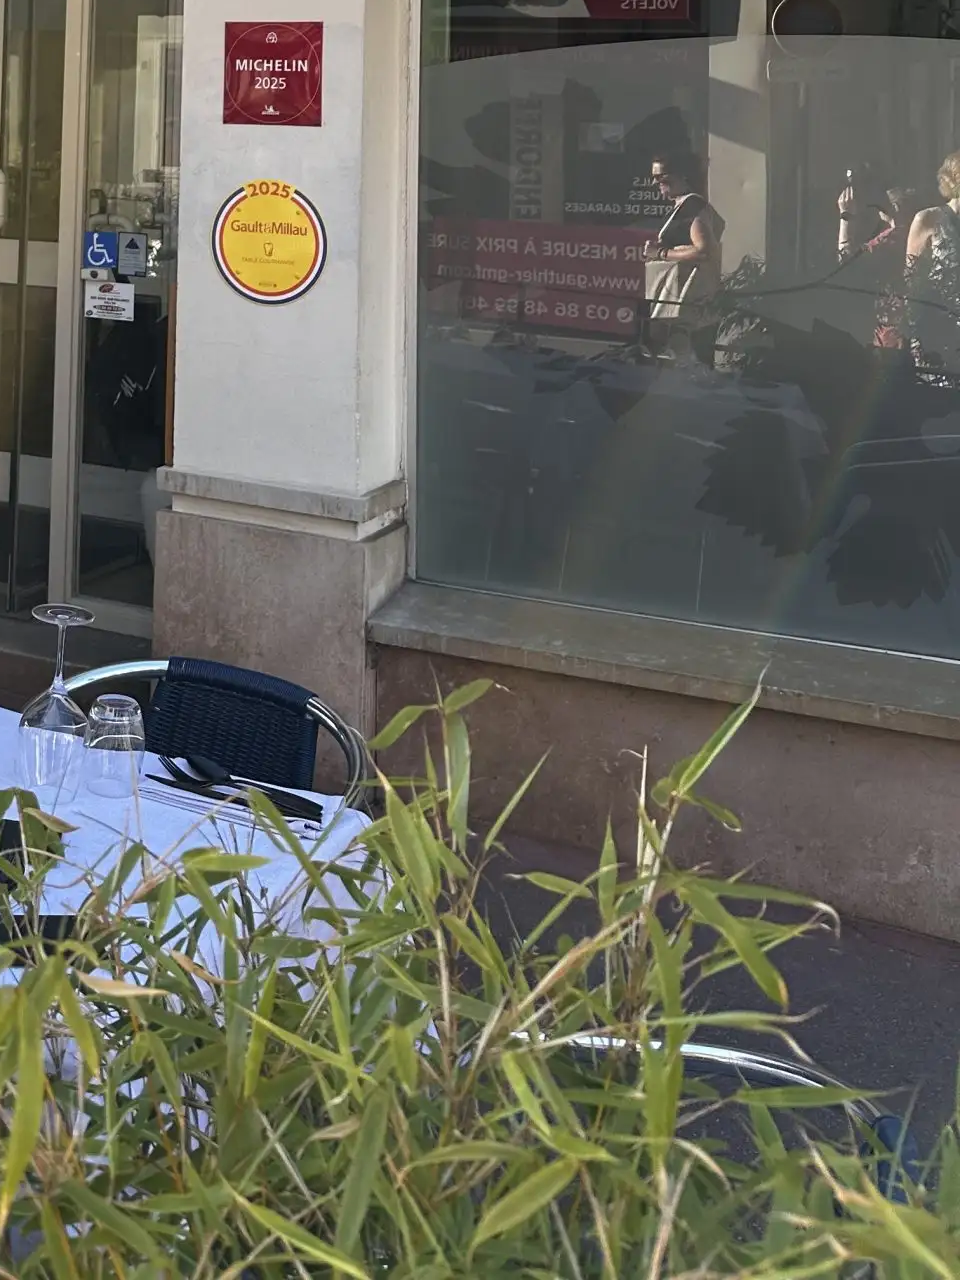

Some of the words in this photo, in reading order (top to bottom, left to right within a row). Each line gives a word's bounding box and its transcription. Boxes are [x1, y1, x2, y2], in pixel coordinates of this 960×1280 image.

[235, 58, 309, 72] MICHELIN
[254, 76, 287, 90] 2025
[247, 181, 292, 199] 2025
[230, 219, 308, 237] Gault&Millau
